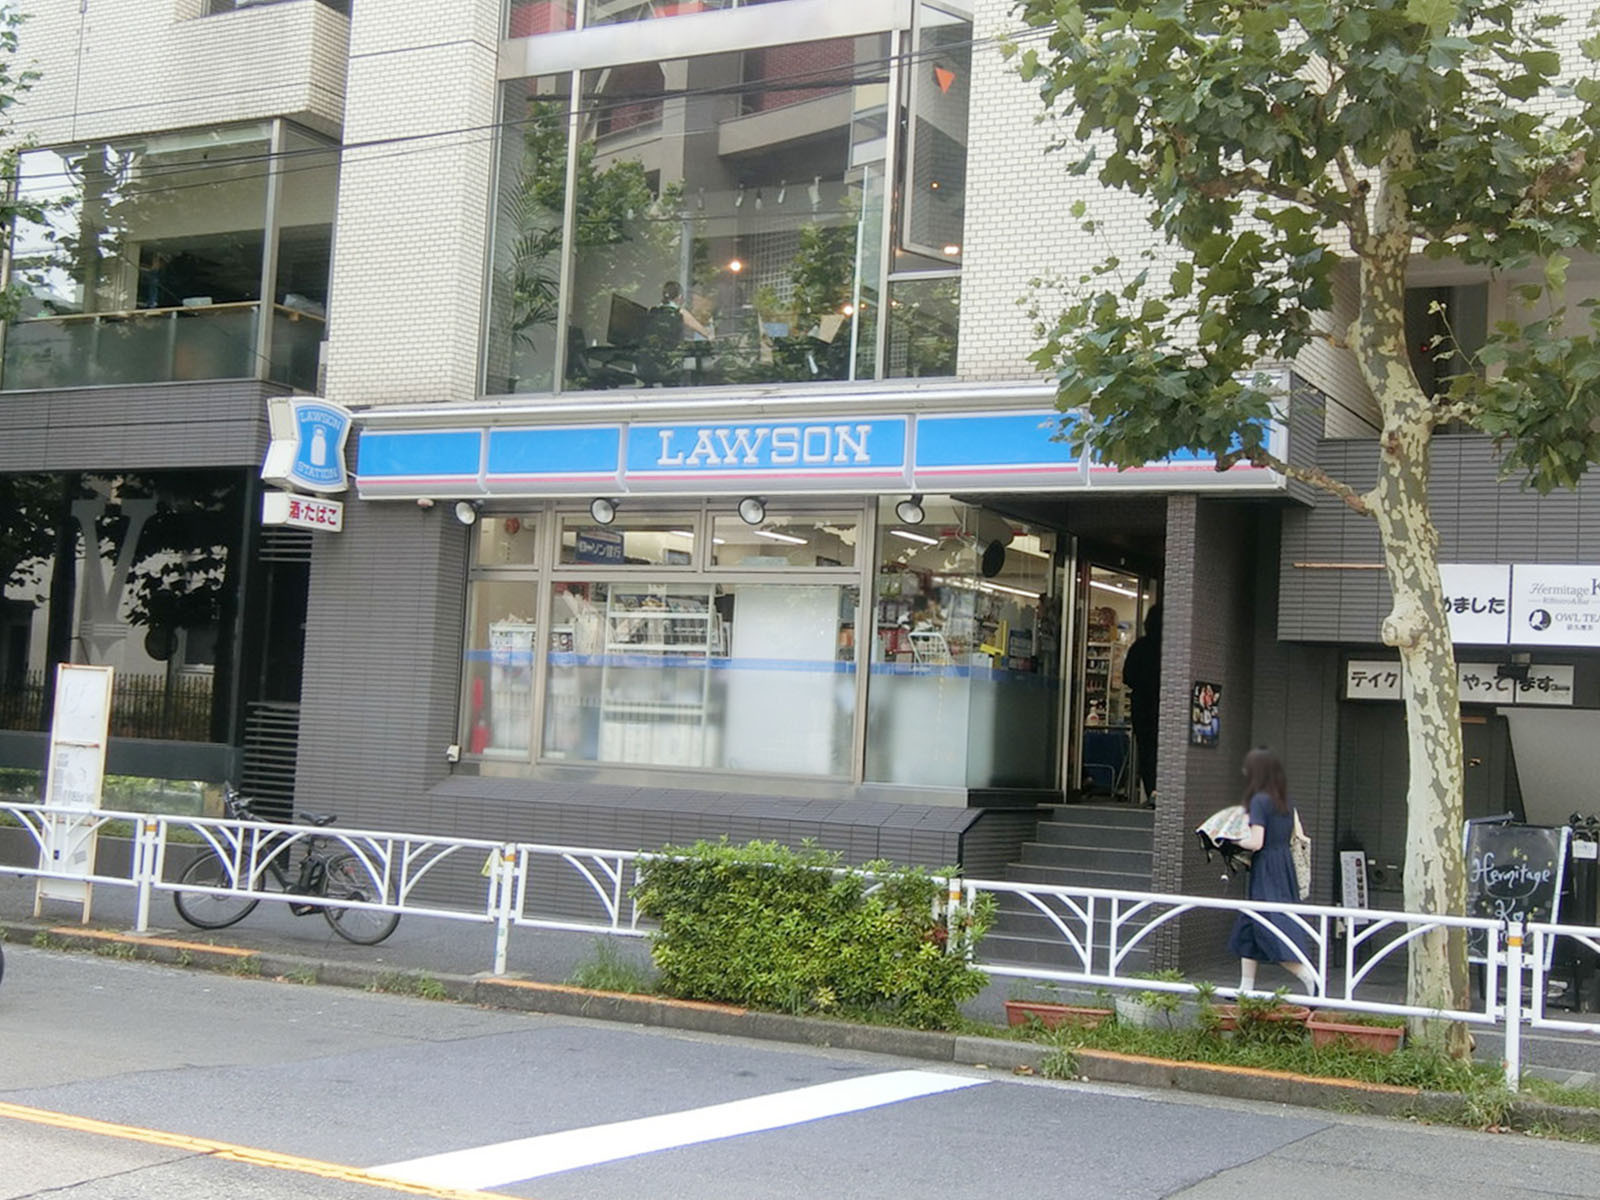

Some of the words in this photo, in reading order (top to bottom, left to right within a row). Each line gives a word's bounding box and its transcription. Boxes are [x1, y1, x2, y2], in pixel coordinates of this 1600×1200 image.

[298, 410, 342, 430] LAWSON
[657, 424, 872, 466] LAWSON
[298, 461, 338, 479] STATION
[289, 500, 337, 526] 酒・たばこ
[1529, 582, 1590, 599] Hermitage
[1555, 612, 1580, 622] OWL
[1351, 671, 1398, 688] テイク
[1470, 852, 1551, 897] Hermitage
